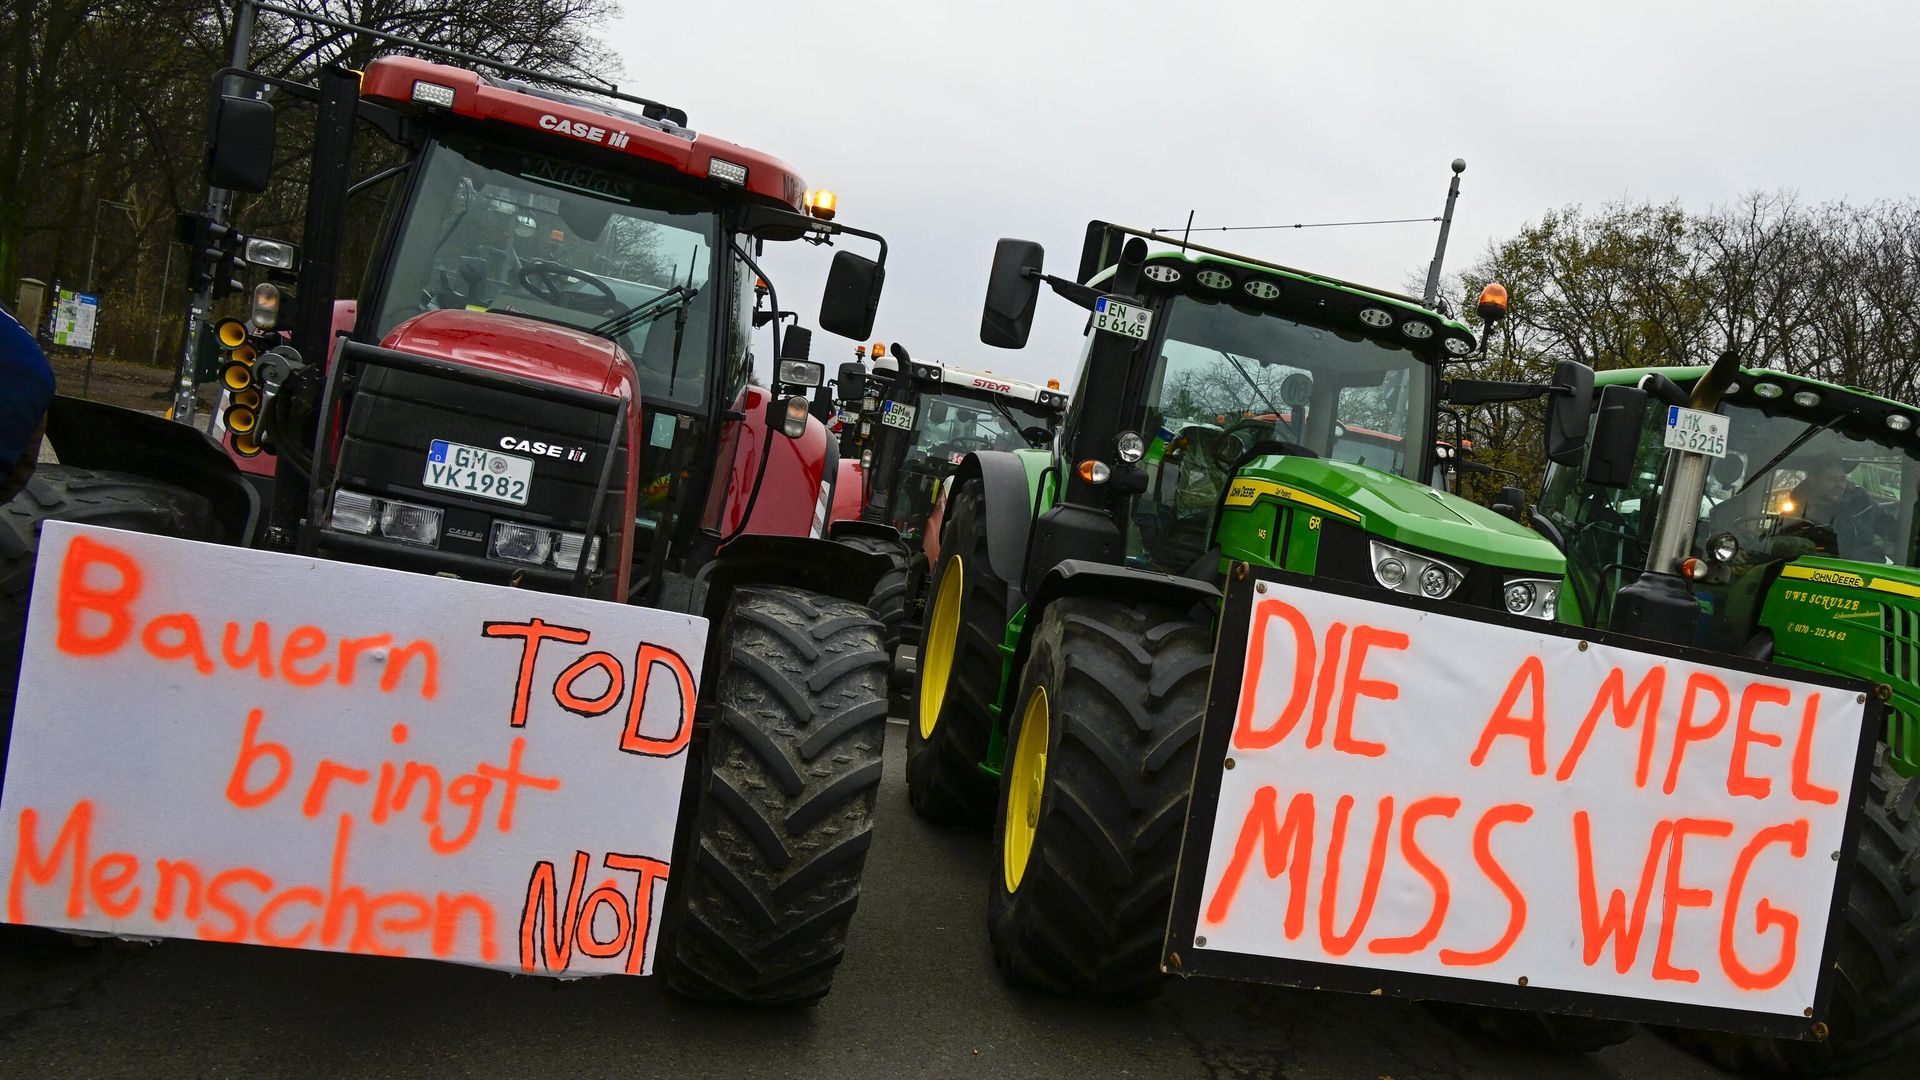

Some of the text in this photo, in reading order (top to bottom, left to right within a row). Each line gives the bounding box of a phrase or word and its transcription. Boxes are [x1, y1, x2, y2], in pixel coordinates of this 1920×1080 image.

[539, 114, 607, 143] CASE
[1108, 302, 1127, 319] EN
[1098, 314, 1145, 338] B 6145
[972, 378, 1012, 394] STEYR
[883, 413, 912, 429] GB 21
[891, 404, 906, 417] GM
[1682, 413, 1703, 432] MK
[500, 436, 564, 458] CASE
[455, 447, 487, 471] GM
[448, 527, 475, 537] CASE
[1309, 515, 1321, 530] 6R
[1809, 570, 1861, 587] JOHN DEERE
[1784, 590, 1860, 611] UWE SCHULZE
[56, 532, 441, 700] Bauern
[1794, 623, 1810, 634] 0170
[1232, 597, 1840, 806] DIE AMPEL
[225, 708, 562, 855] bringt
[6, 798, 670, 975] Menschen NOT
[1204, 785, 1810, 991] MUSS WEG
